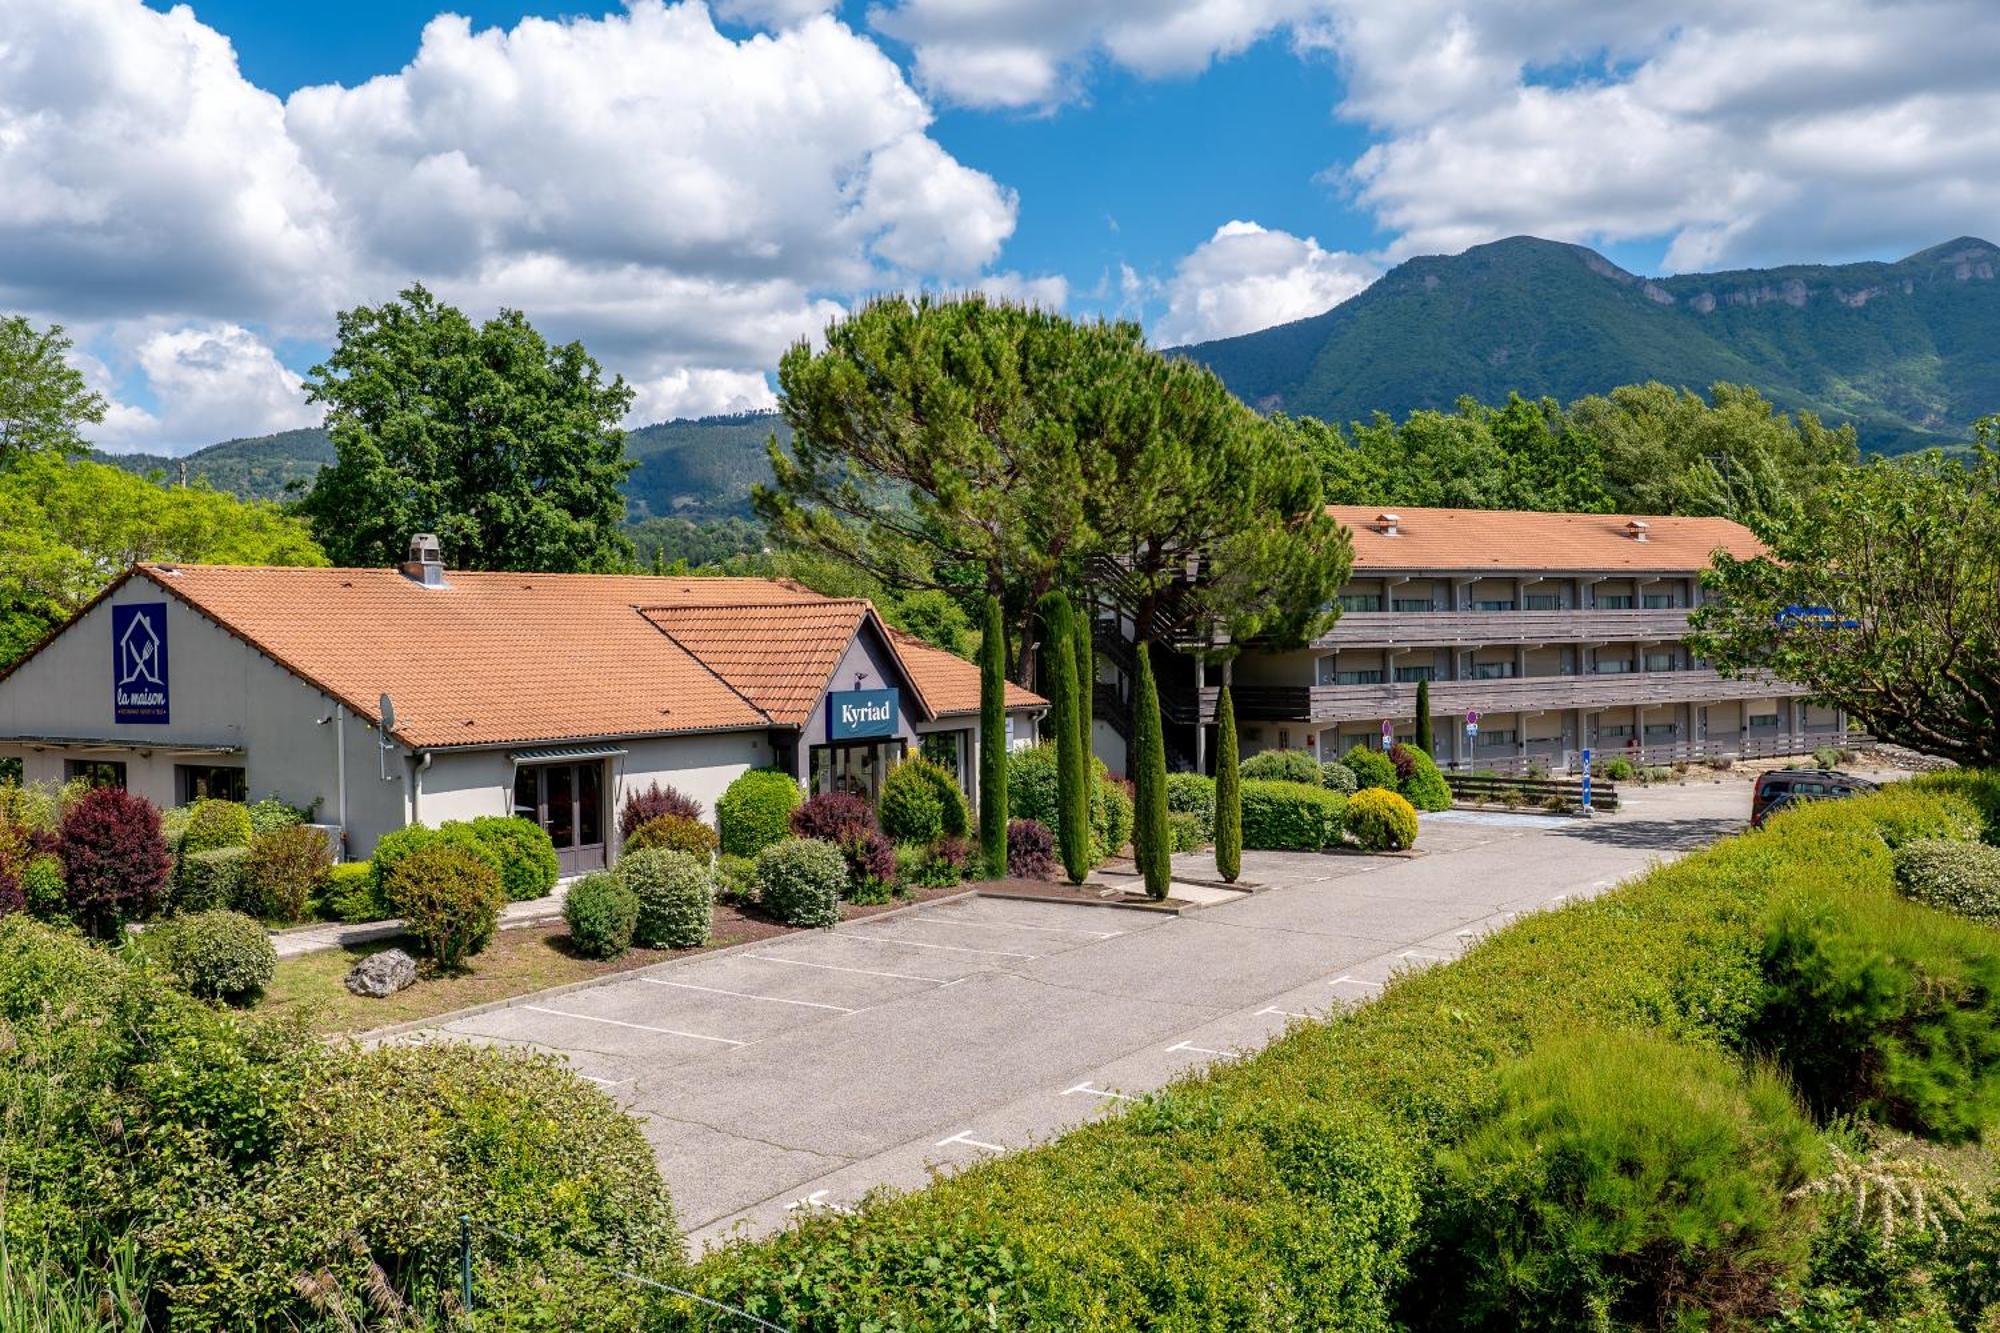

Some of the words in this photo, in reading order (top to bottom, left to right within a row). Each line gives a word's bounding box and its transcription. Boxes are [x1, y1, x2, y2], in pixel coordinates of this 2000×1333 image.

[117, 687, 130, 705] la
[130, 688, 166, 706] maison
[842, 700, 890, 728] Kyriad
